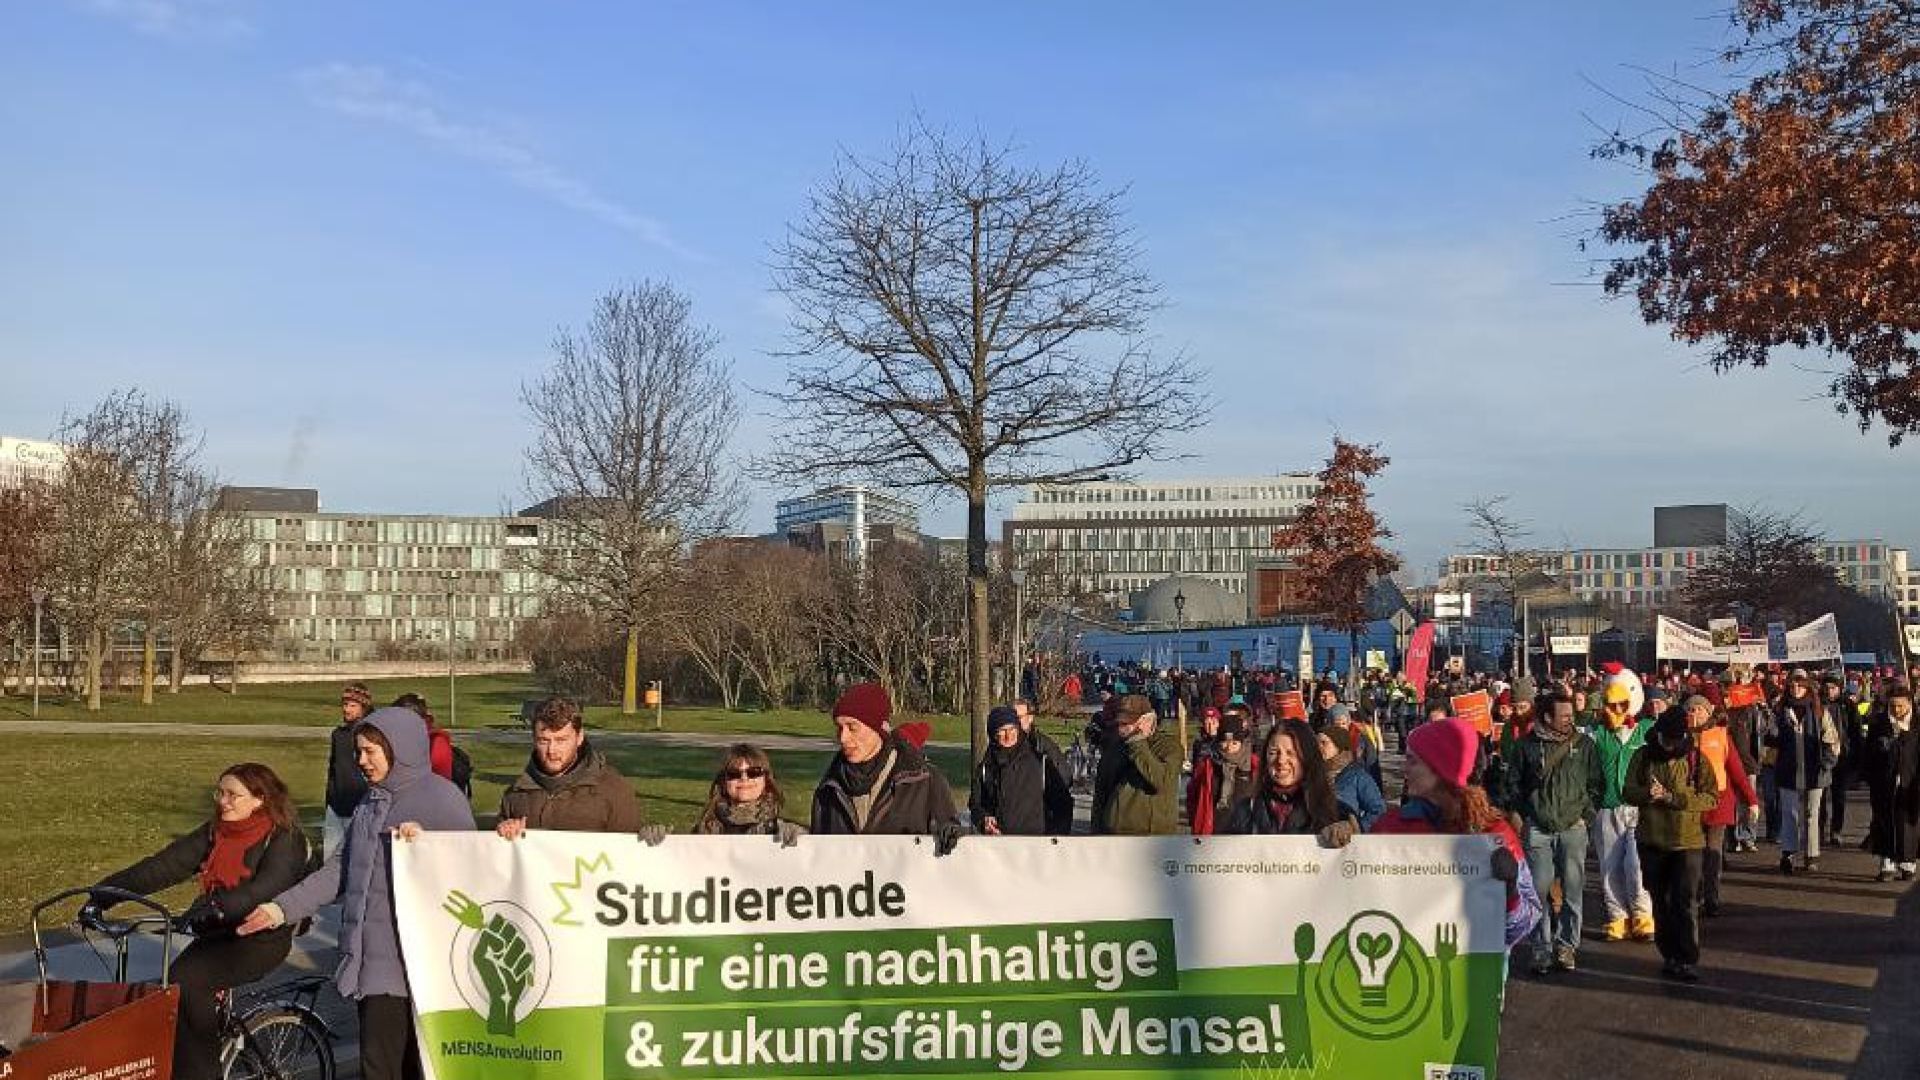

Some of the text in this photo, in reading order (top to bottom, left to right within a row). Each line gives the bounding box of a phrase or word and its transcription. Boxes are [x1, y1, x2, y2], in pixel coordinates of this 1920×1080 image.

[1183, 859, 1321, 876] mensarevolution.de
[1359, 861, 1480, 877] mensarevolution
[595, 870, 906, 926] Studierende
[627, 931, 1158, 993] für eine nachhaltige
[441, 1040, 563, 1061] MENSArevolution
[624, 1004, 1286, 1071] & zukunfsfähige Mensa!
